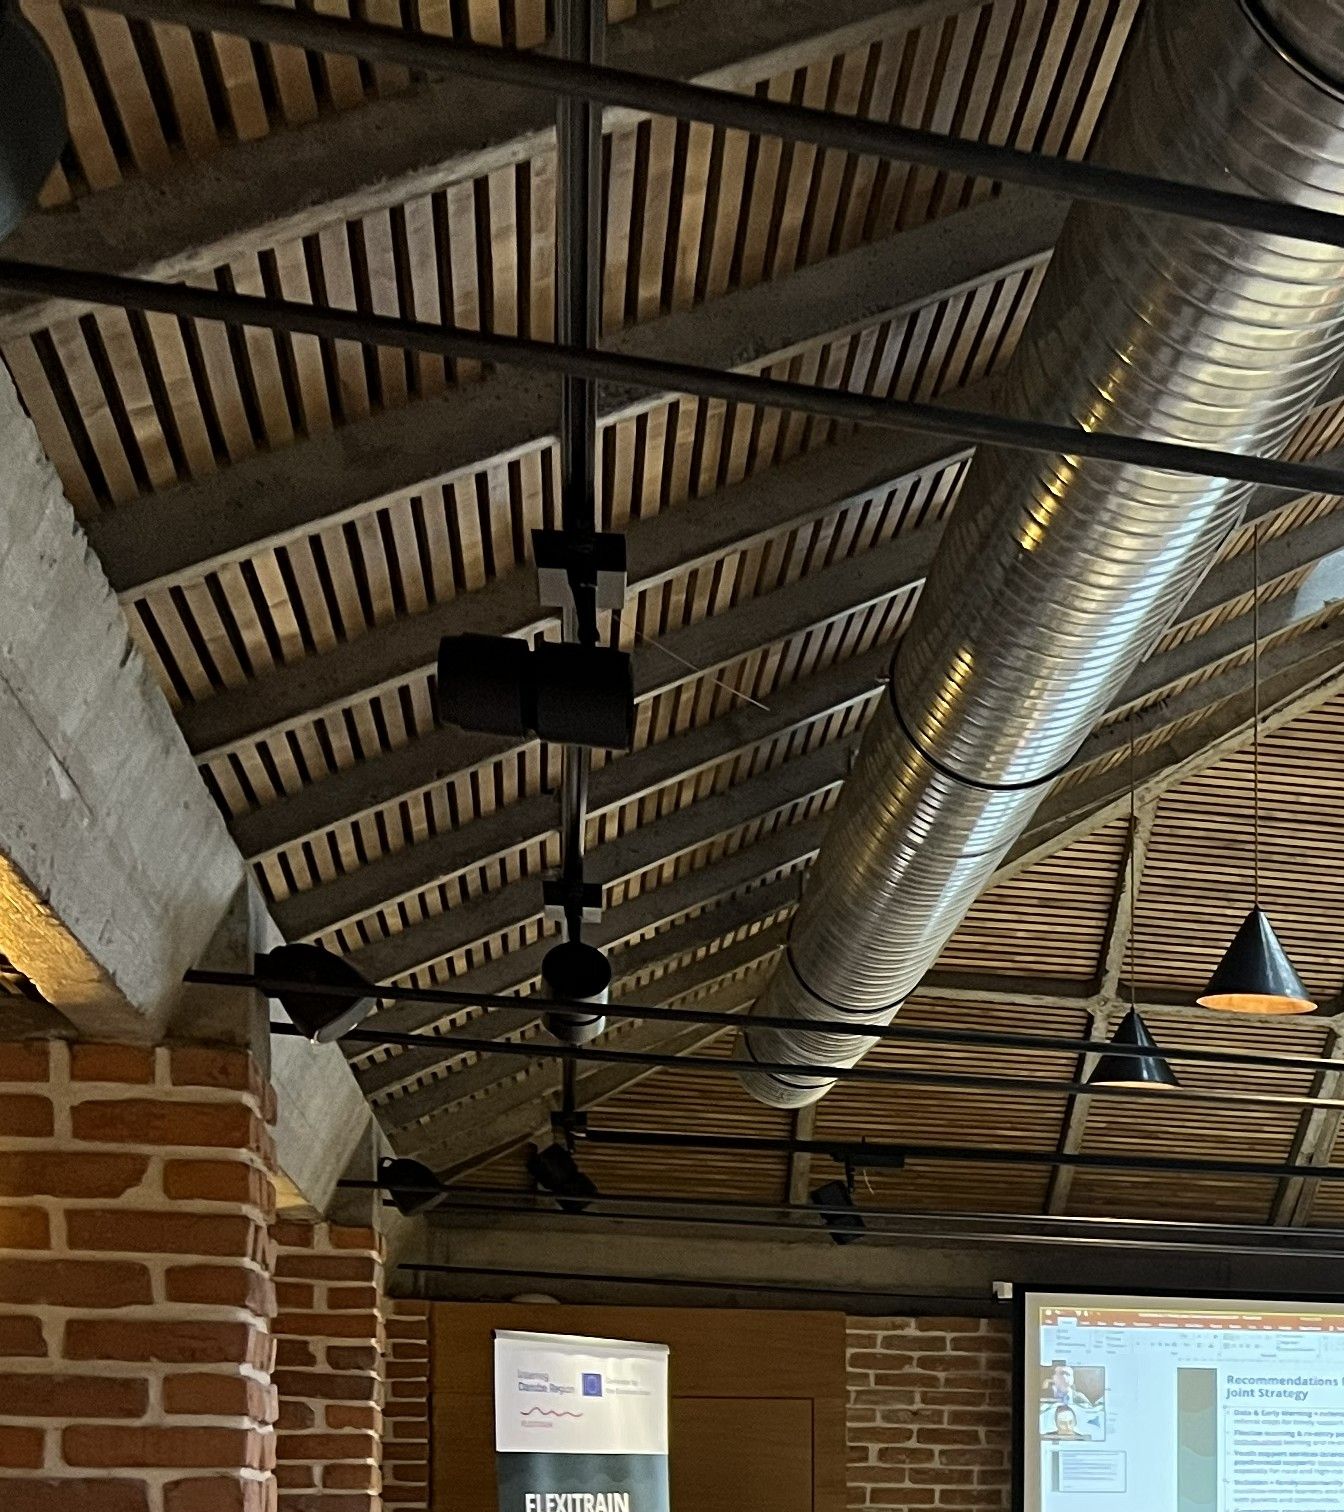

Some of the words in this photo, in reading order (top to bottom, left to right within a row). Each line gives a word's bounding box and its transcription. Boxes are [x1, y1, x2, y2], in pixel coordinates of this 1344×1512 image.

[1226, 1375, 1339, 1387] Recommendations
[1226, 1388, 1256, 1400] Joint
[1258, 1389, 1309, 1401] Strategy
